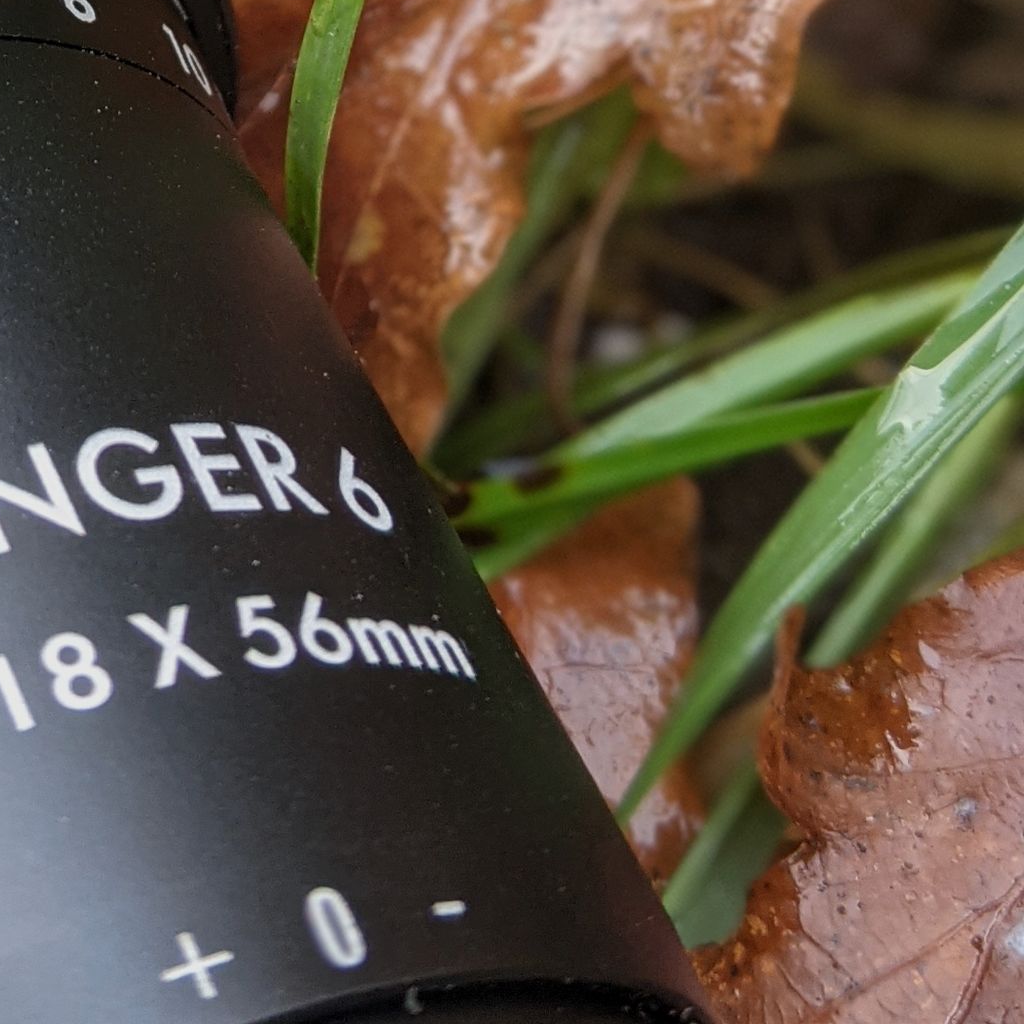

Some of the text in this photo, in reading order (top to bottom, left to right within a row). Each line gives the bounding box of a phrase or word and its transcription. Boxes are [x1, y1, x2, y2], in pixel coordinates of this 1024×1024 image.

[162, 23, 212, 96] 10
[338, 445, 394, 534] 6
[126, 604, 222, 688] X
[235, 591, 477, 682] 56mm
